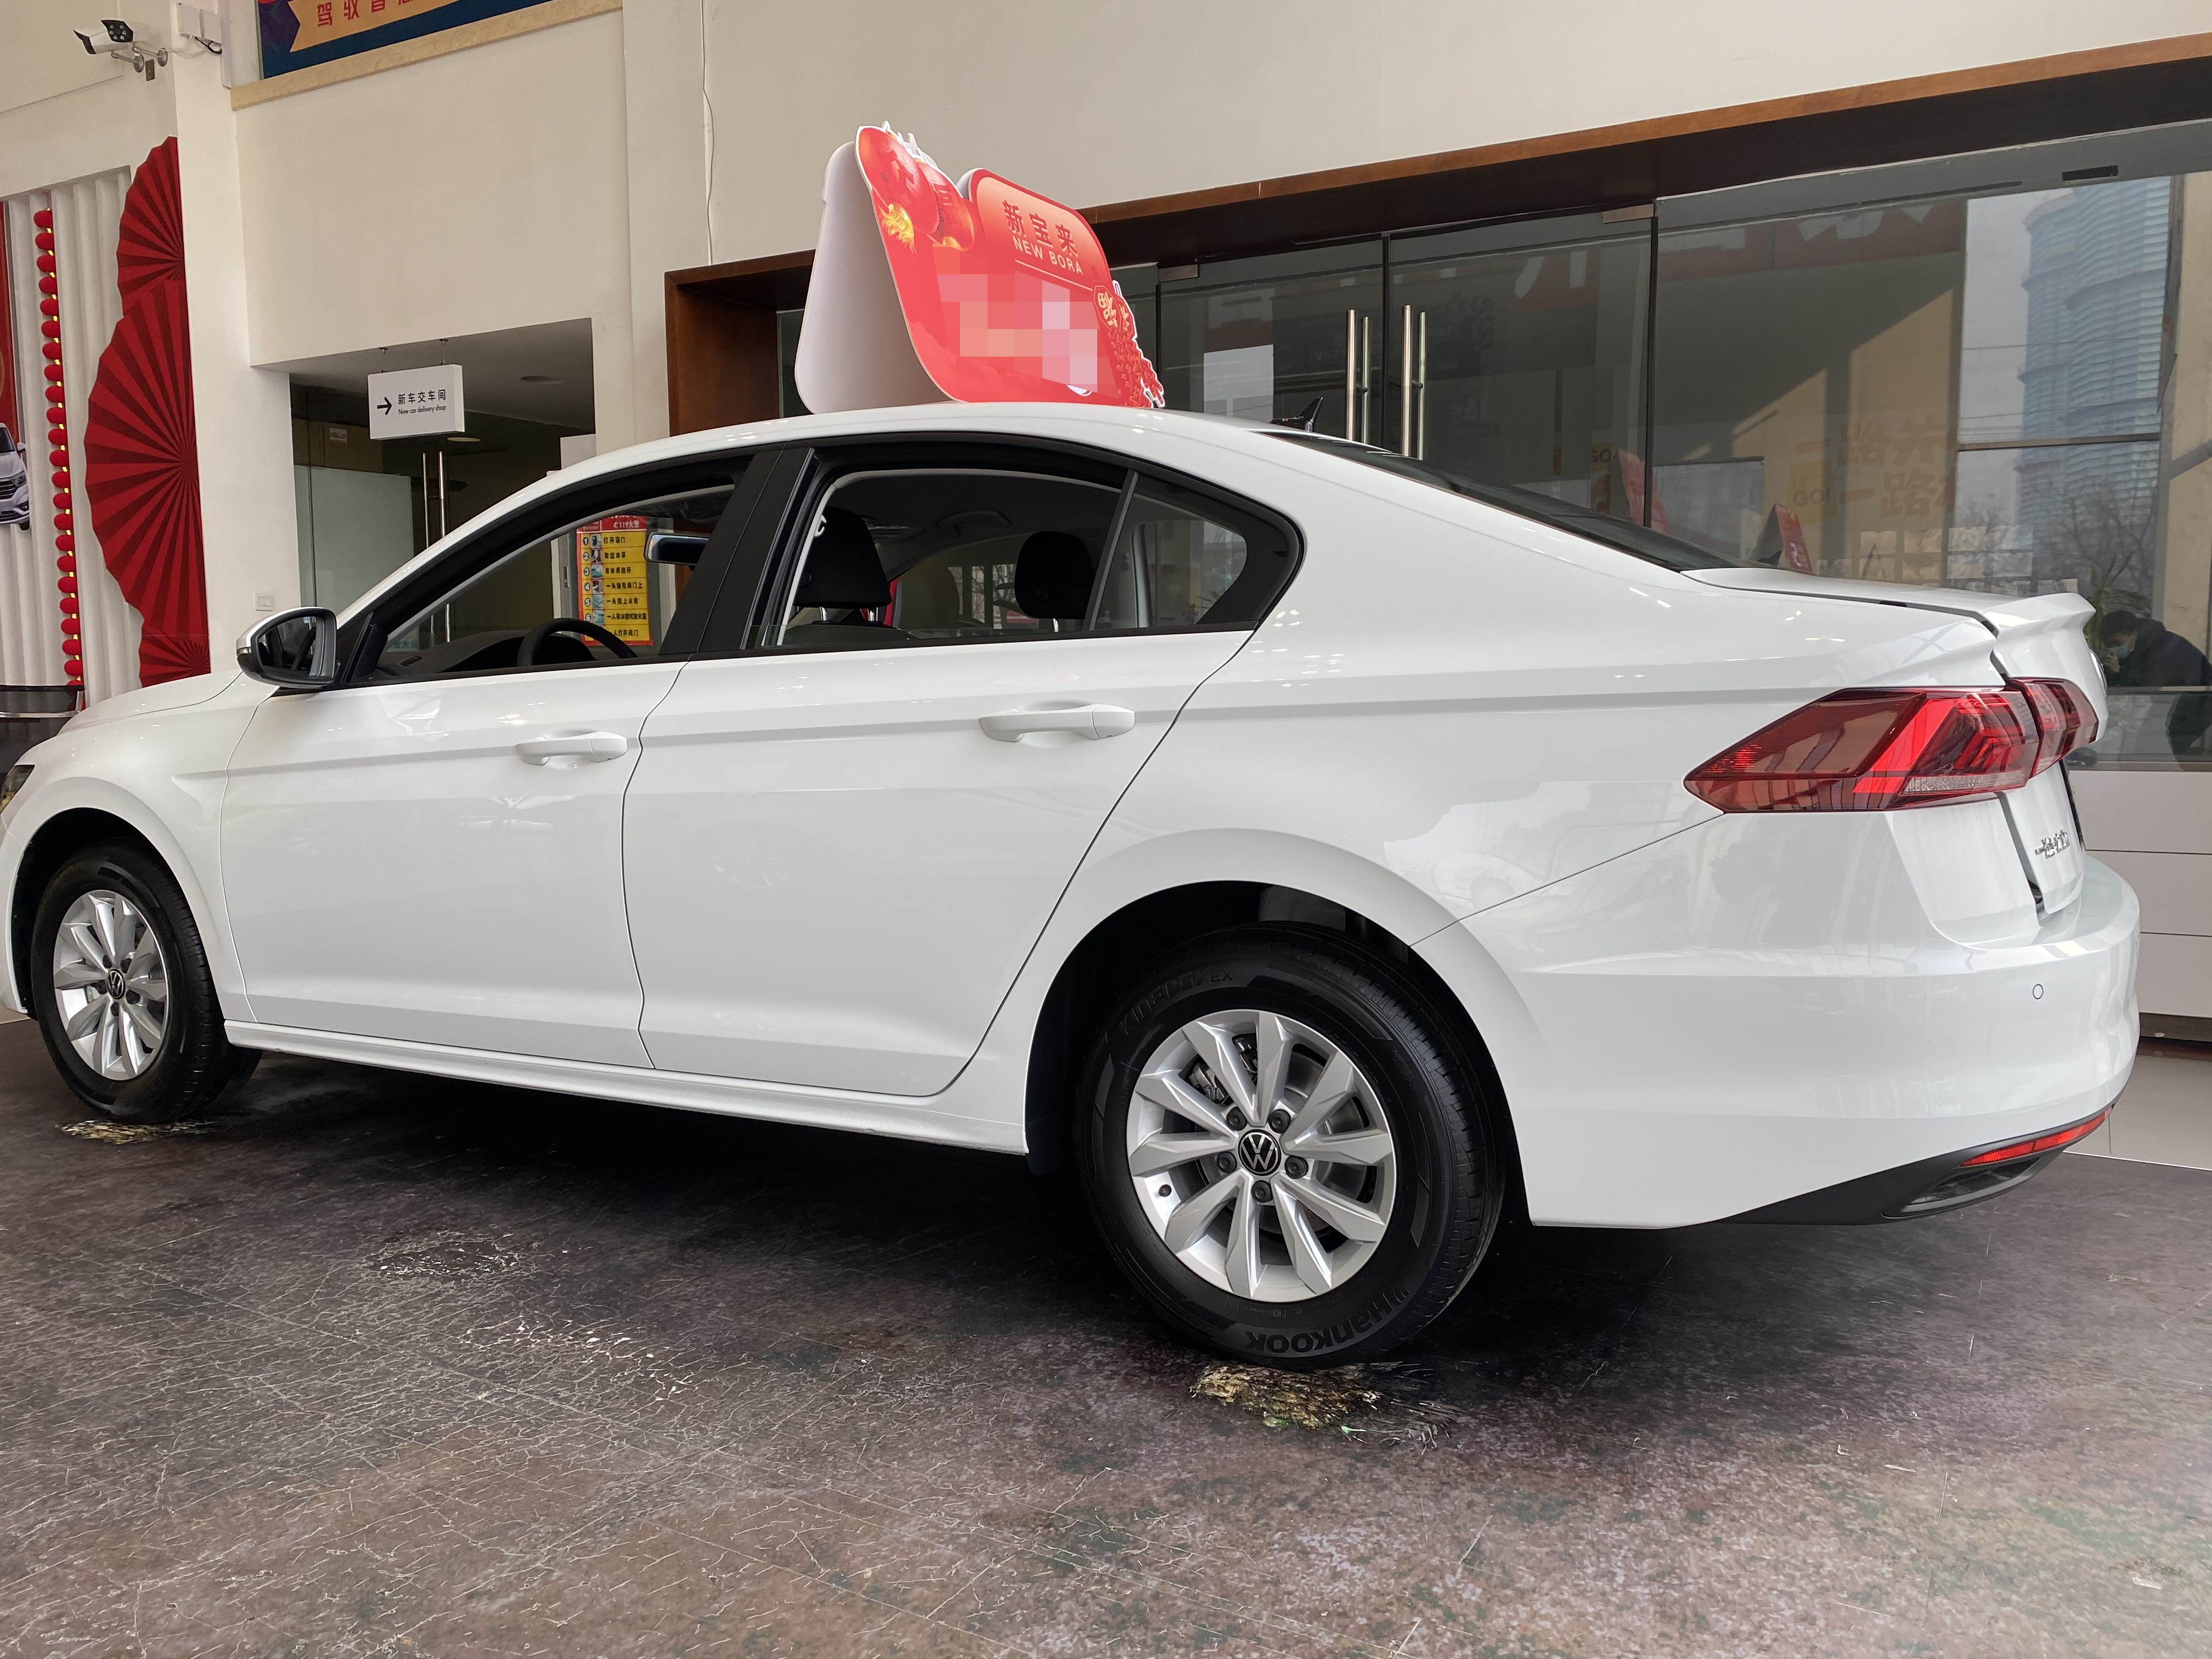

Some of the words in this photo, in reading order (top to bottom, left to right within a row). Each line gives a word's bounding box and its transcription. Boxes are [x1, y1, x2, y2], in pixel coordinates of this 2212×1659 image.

[1002, 199, 1079, 258] 新宝来
[1013, 235, 1043, 259] NEW
[1049, 250, 1084, 276] BORA
[398, 389, 446, 405] 新车交车间
